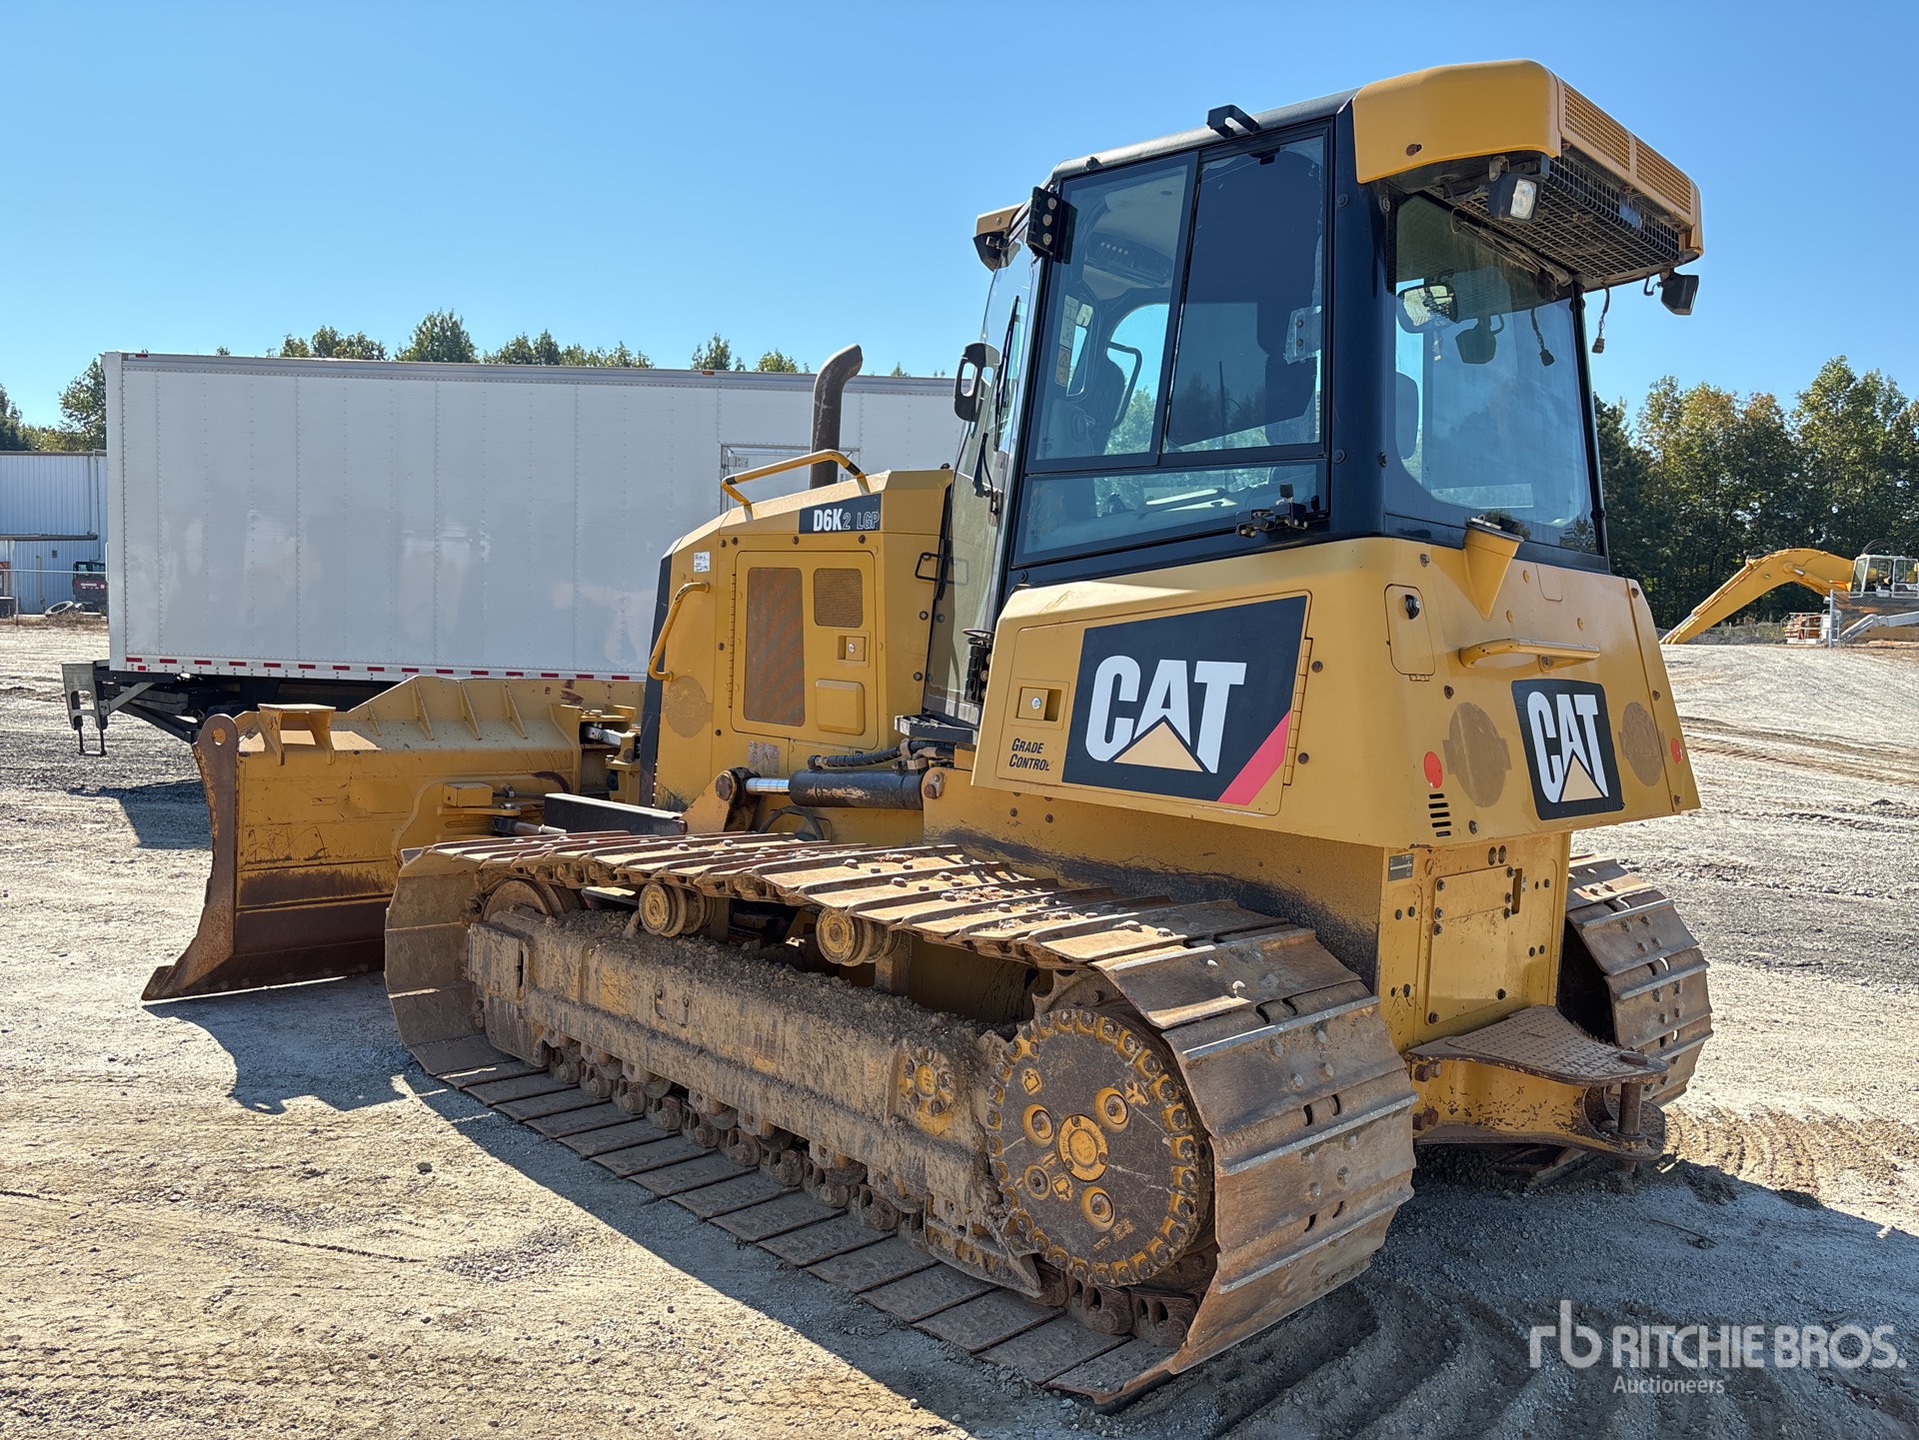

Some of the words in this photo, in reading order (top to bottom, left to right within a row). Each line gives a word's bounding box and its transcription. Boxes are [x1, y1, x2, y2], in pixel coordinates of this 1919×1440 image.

[857, 511, 879, 529] LGP
[1011, 738, 1044, 754] GRADE
[1085, 655, 1247, 774] CAT
[1527, 691, 1609, 803] CAT
